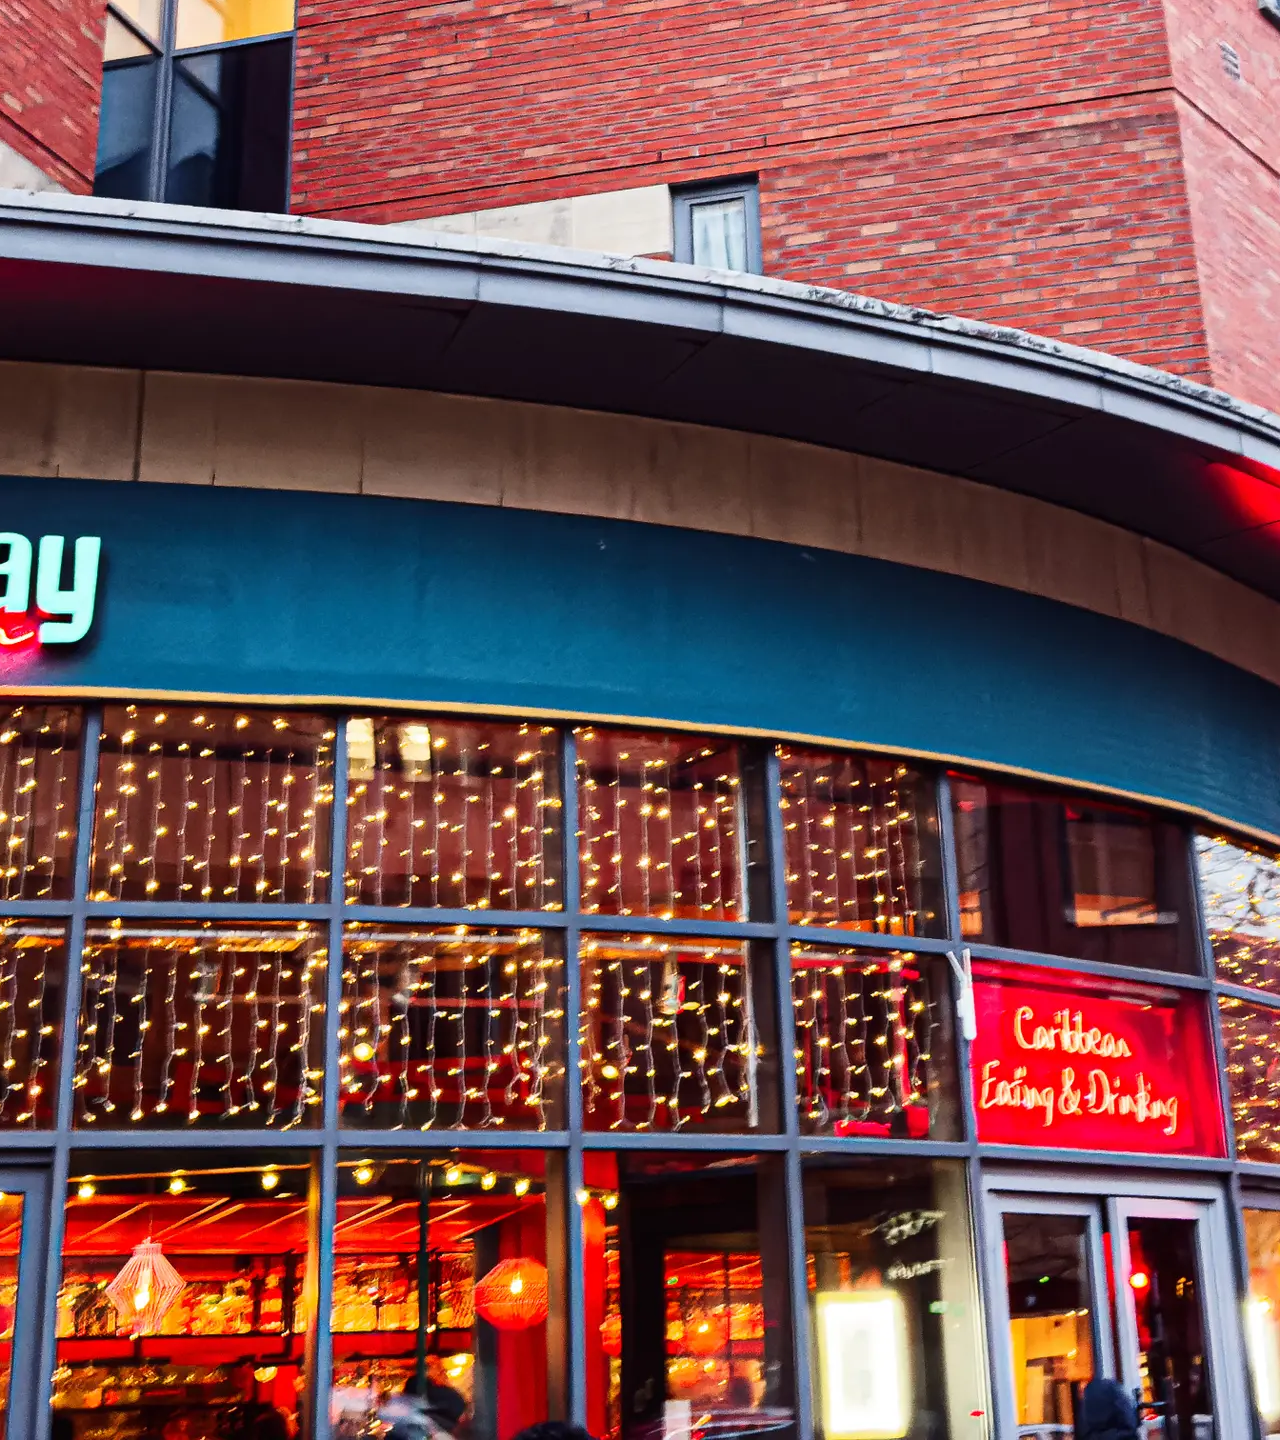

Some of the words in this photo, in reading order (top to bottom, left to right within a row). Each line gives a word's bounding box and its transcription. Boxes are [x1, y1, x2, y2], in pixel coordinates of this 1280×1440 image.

[1013, 1005, 1132, 1058] Caribbean
[979, 1059, 1054, 1127] Eating
[1058, 1066, 1083, 1116] &
[1085, 1068, 1178, 1136] Drinking
